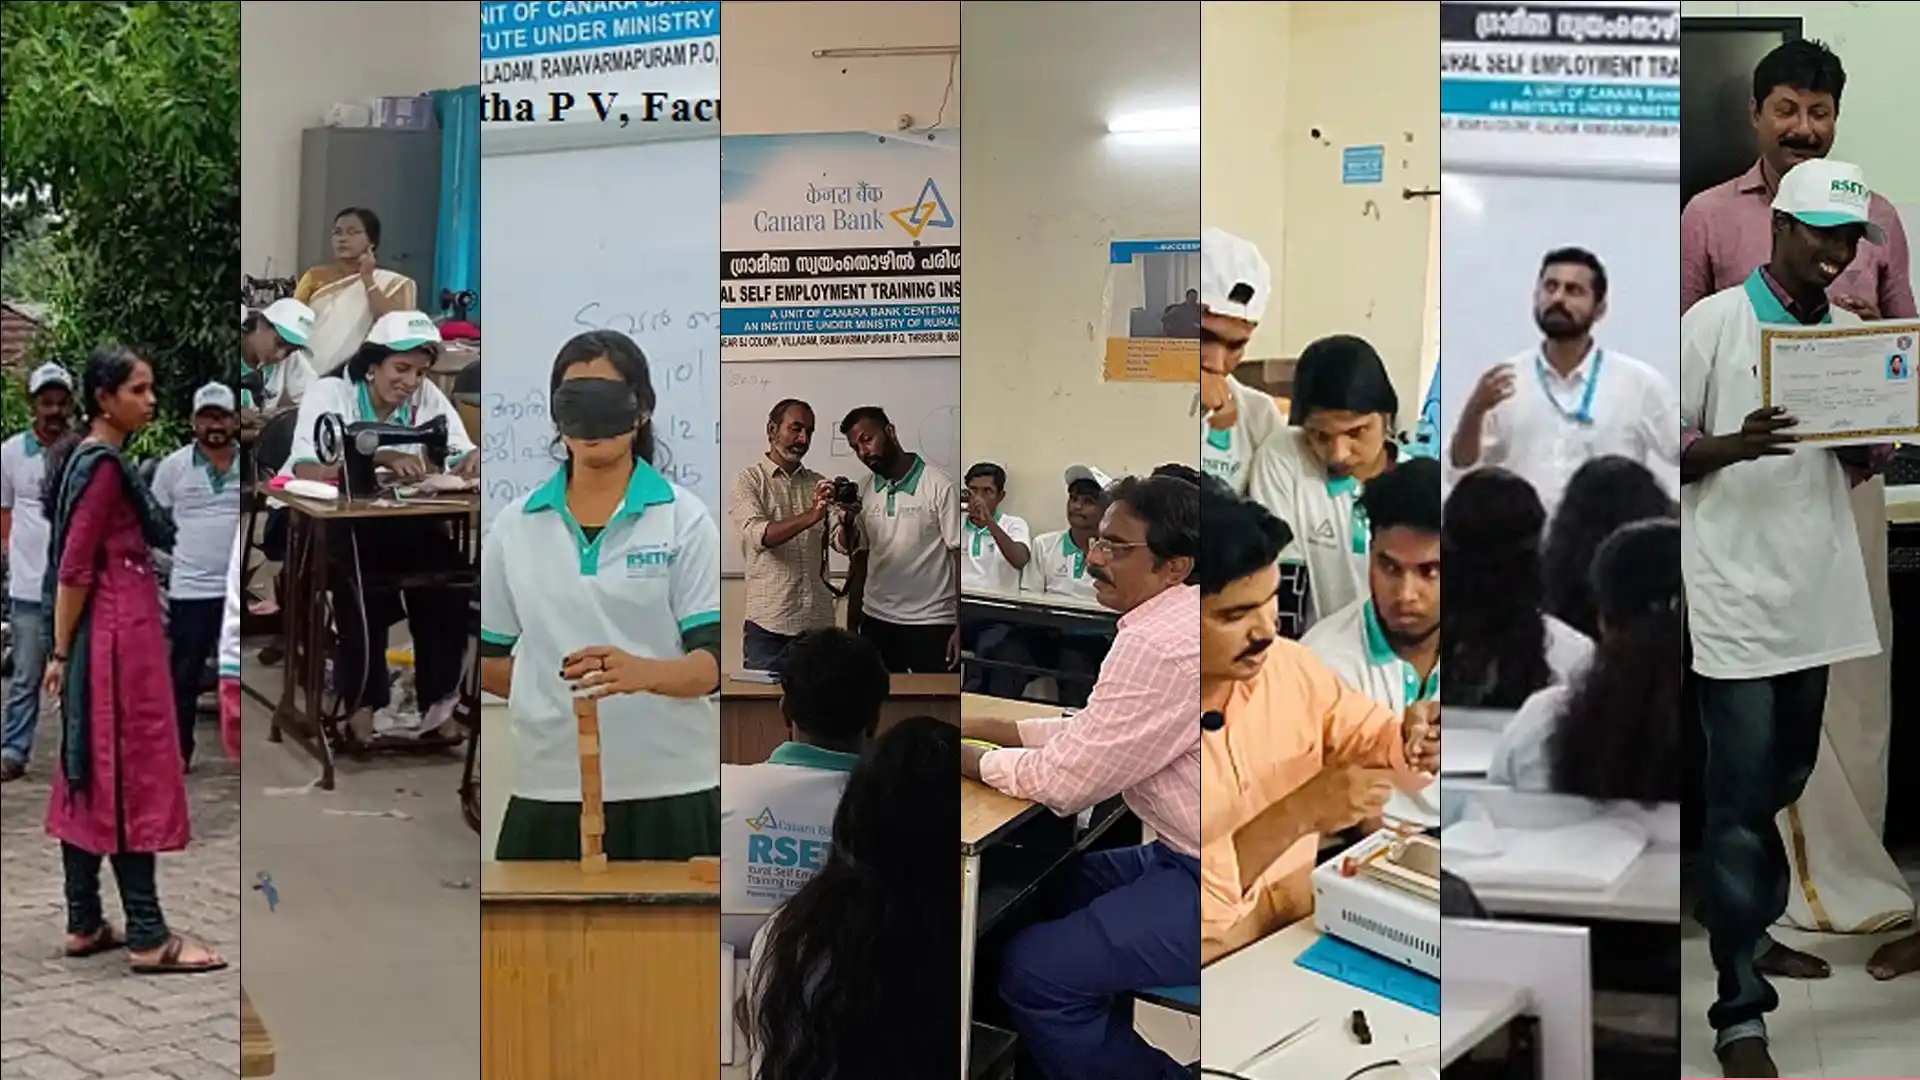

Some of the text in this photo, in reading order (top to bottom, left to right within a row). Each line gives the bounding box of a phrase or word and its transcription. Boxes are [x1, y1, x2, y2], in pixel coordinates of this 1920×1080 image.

[513, 1, 541, 21] OF
[533, 21, 607, 46] UNDER
[613, 8, 715, 38] MINISTRY
[481, 60, 538, 84] LADAM,
[541, 44, 685, 78] RAMAVARMAPURAM
[806, 183, 850, 204] केनरा
[754, 208, 884, 233] Canara Bank
[730, 252, 790, 278] ഗ്രാമീണ
[740, 284, 771, 302] SELF
[775, 283, 866, 302] EMPLOYMENT
[871, 281, 936, 300] TRAINING
[744, 316, 960, 332] AN INSTITUTE UNDER MINISTRY OF RURAL
[770, 309, 778, 320] A
[781, 308, 804, 320] UNIT
[806, 308, 821, 318] OF
[823, 306, 868, 318] CANARA
[871, 306, 900, 317] BANK
[749, 834, 834, 868] RSE
